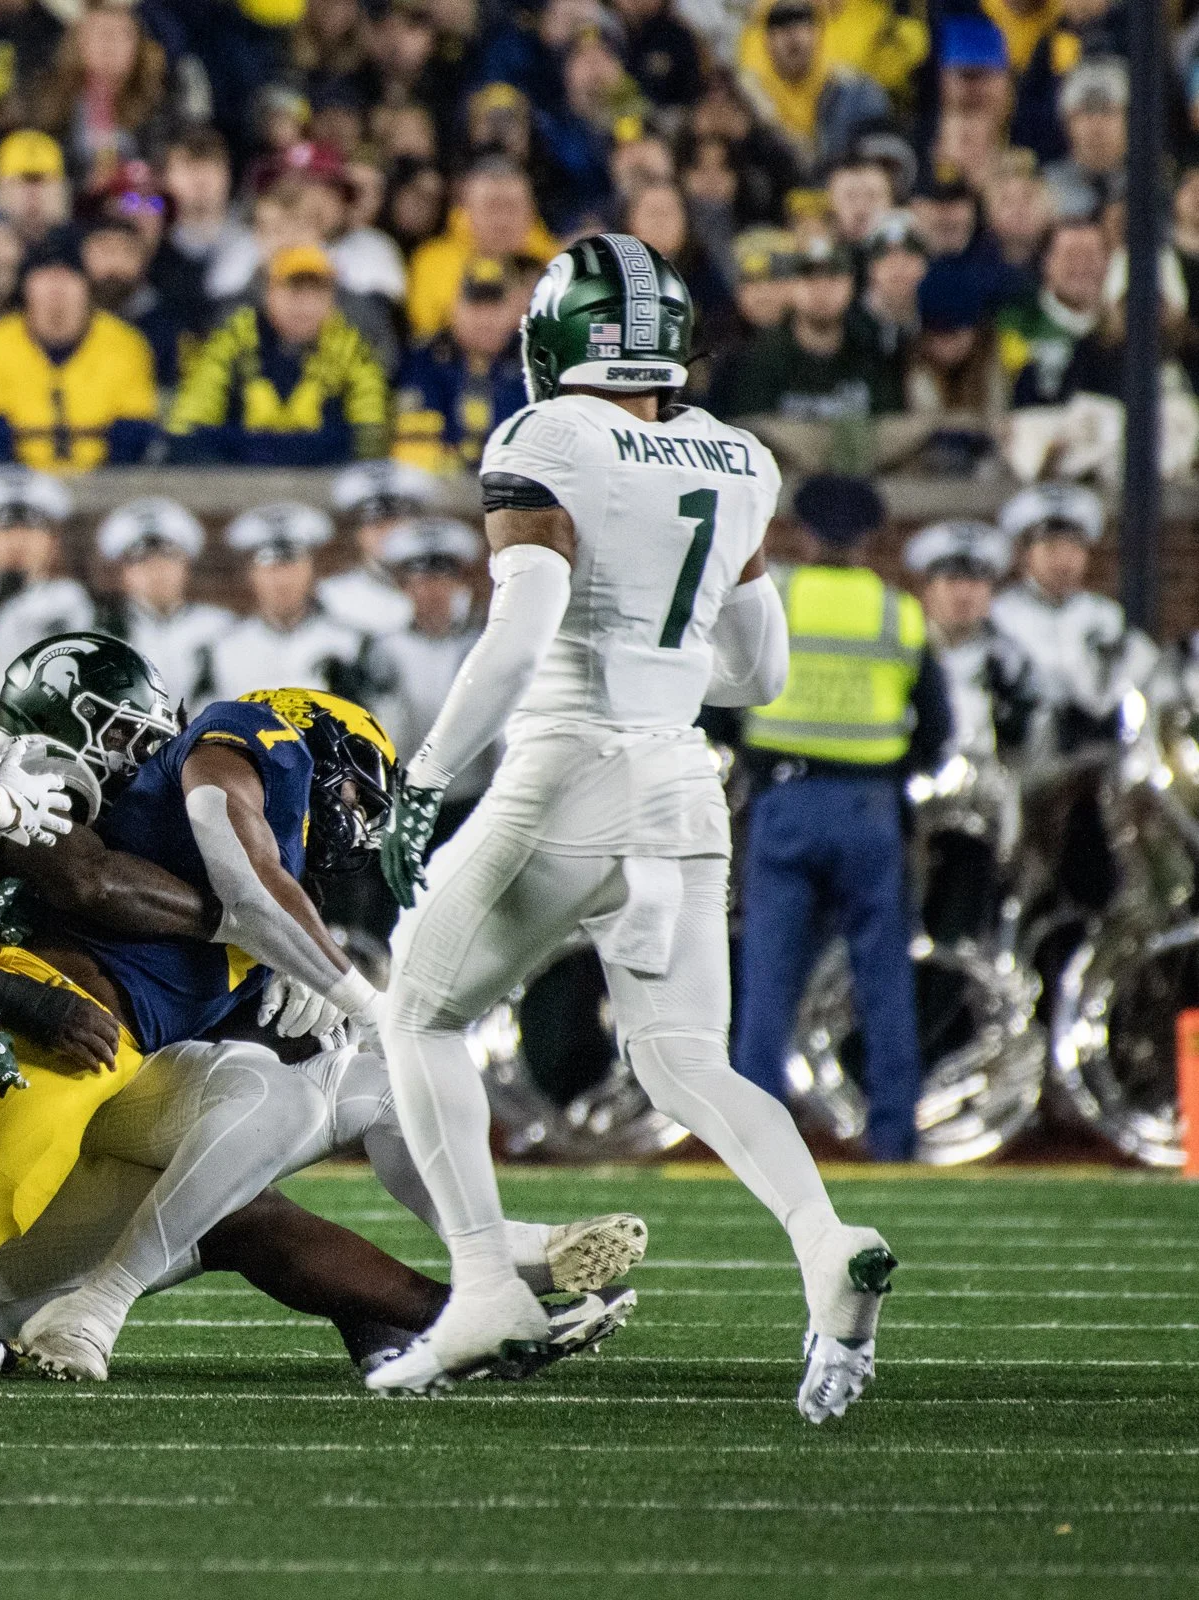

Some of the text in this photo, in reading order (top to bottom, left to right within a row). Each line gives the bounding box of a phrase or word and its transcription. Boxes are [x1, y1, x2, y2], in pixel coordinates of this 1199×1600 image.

[606, 367, 672, 381] SPARTANS
[610, 428, 757, 477] MARTINEZ
[659, 487, 719, 649] 1
